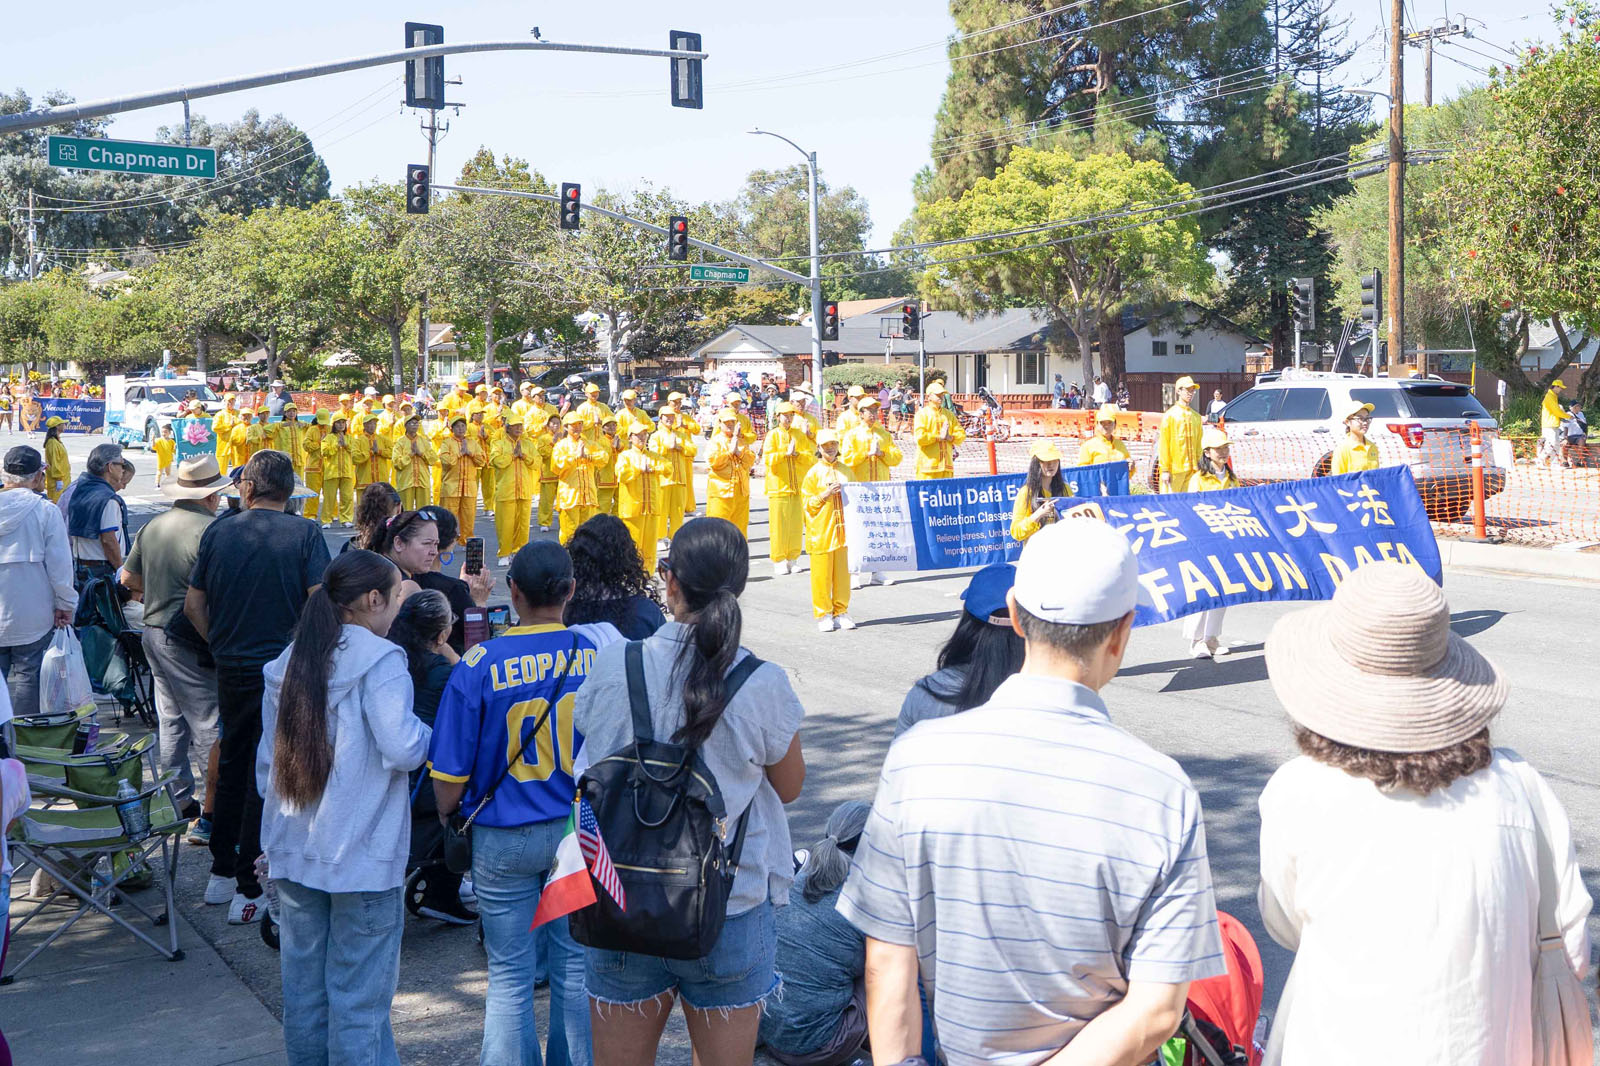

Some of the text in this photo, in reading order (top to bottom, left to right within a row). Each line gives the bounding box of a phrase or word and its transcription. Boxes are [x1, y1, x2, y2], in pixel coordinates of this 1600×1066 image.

[88, 147, 206, 170] Chapman Dr
[704, 270, 746, 280] Chapman Dr
[919, 489, 963, 508] Falun
[967, 485, 1003, 505] Dafa
[928, 511, 1013, 528] Meditation Classes
[1109, 483, 1395, 555] 法輪大法
[936, 529, 1011, 543] Relieve stress, Unblo
[944, 541, 1021, 557] Improve physical and
[862, 554, 908, 563] FalunDafa.org
[1138, 551, 1309, 613] FALUN
